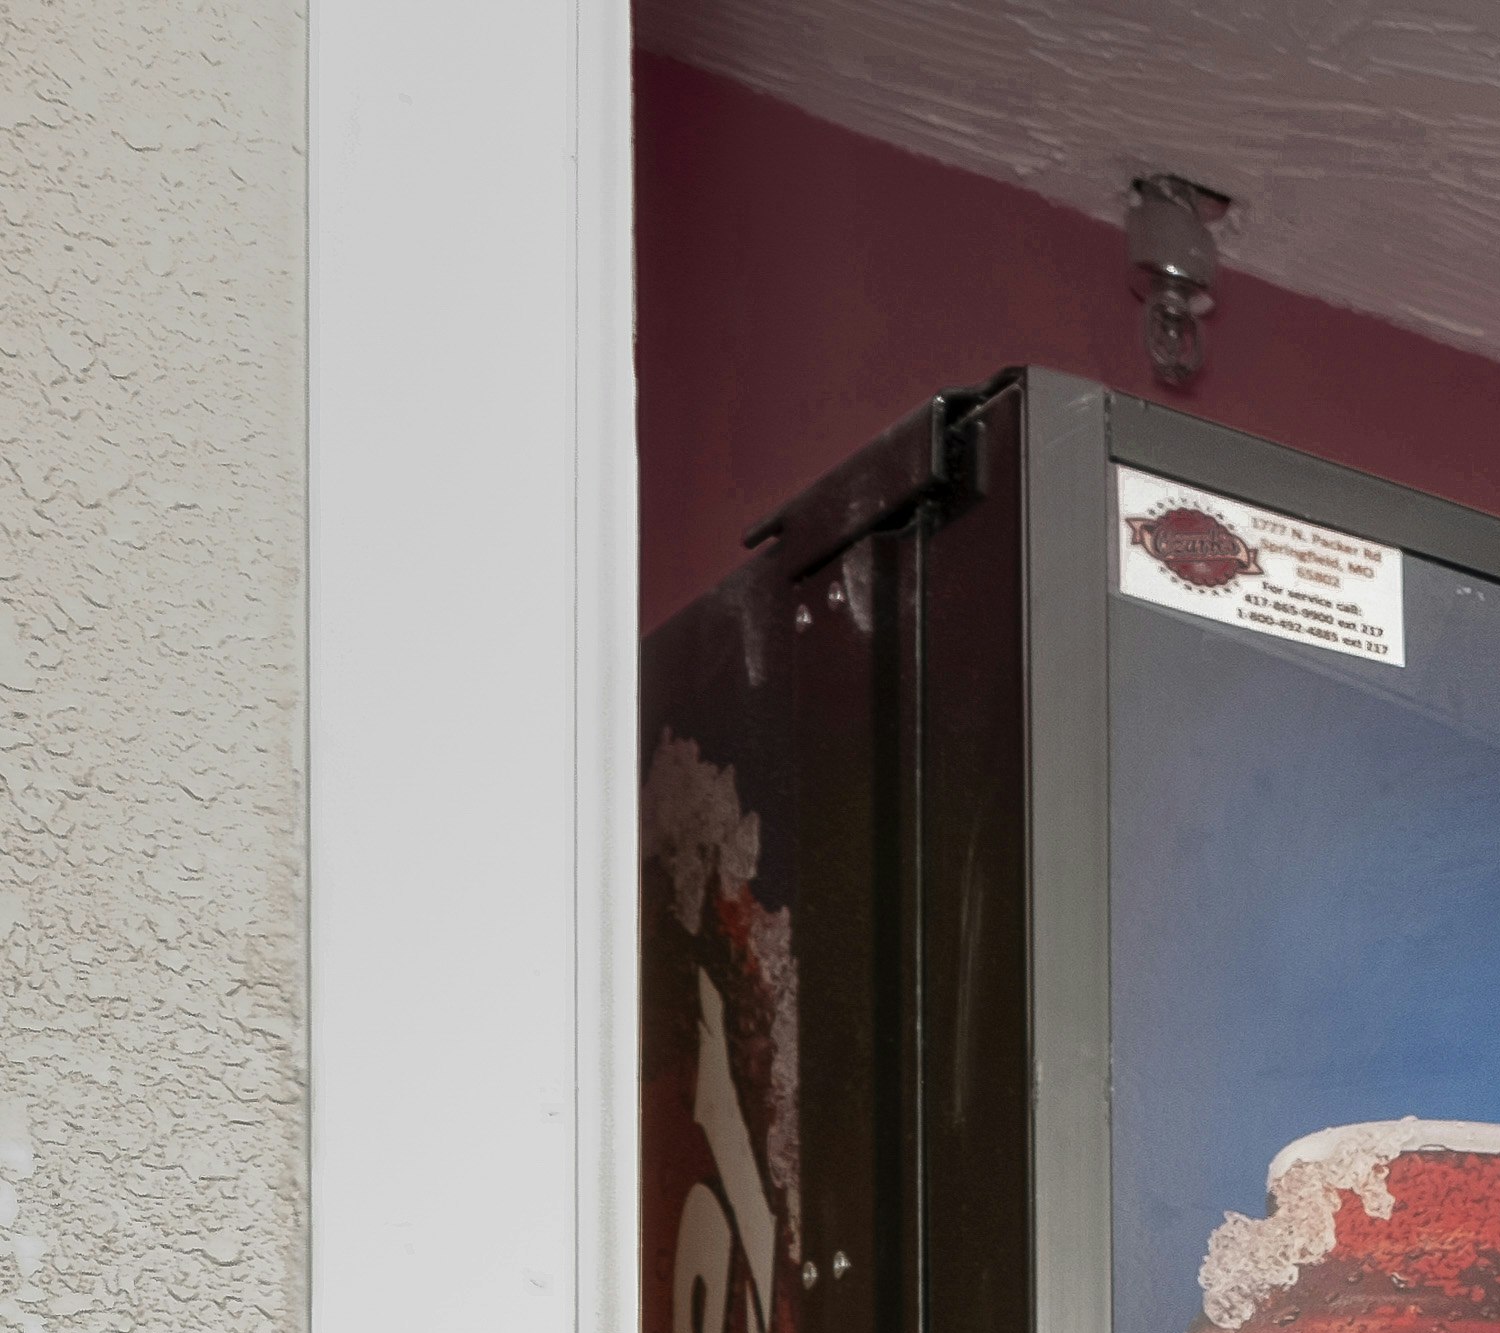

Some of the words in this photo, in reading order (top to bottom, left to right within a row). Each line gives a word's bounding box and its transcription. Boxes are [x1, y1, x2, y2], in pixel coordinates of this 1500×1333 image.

[1259, 538, 1344, 573] Springfield,
[1348, 561, 1375, 579] MO
[1311, 533, 1359, 556] Packer
[1363, 547, 1383, 563] Rd
[1262, 580, 1283, 596] For
[1288, 588, 1332, 609] service
